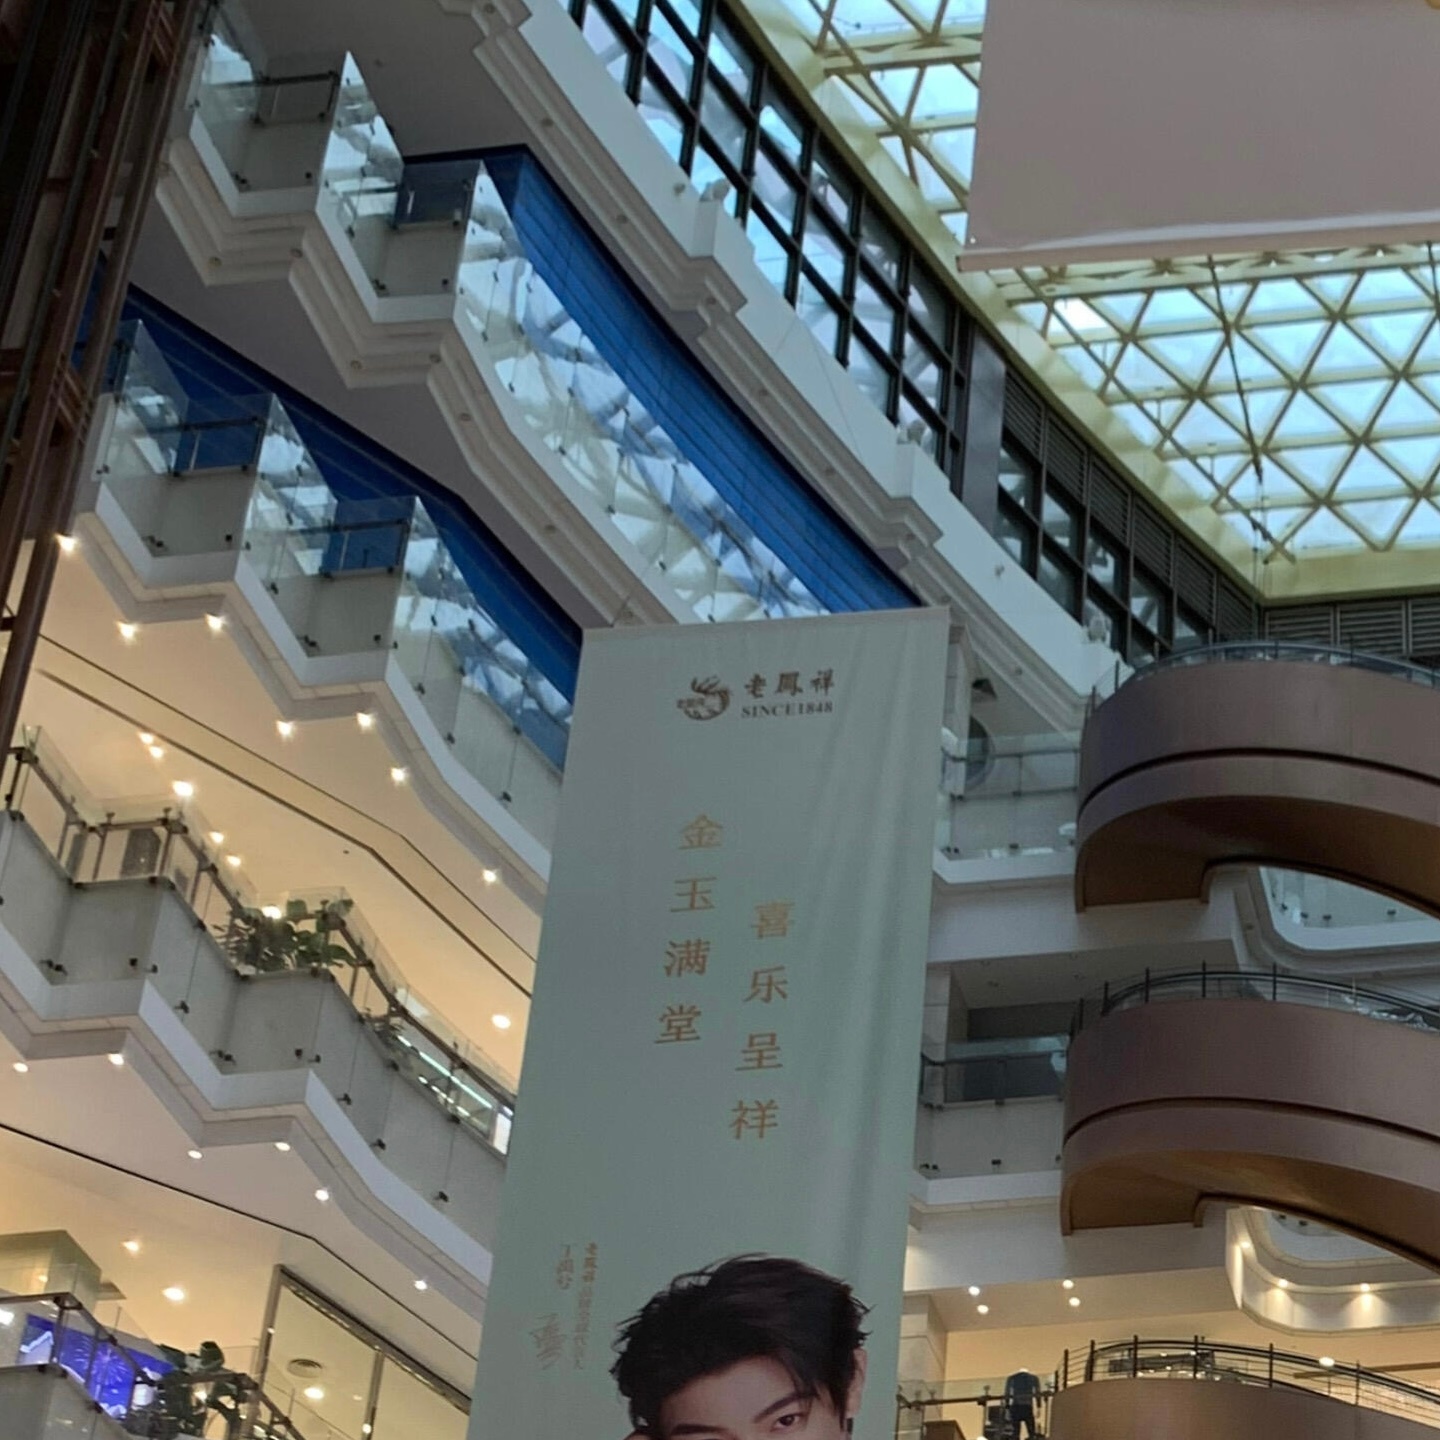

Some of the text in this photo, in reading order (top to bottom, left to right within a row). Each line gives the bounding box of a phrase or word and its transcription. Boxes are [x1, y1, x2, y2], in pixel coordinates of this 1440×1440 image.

[654, 813, 724, 1045] 金玉满堂
[729, 899, 797, 1140] 喜乐呈祥
